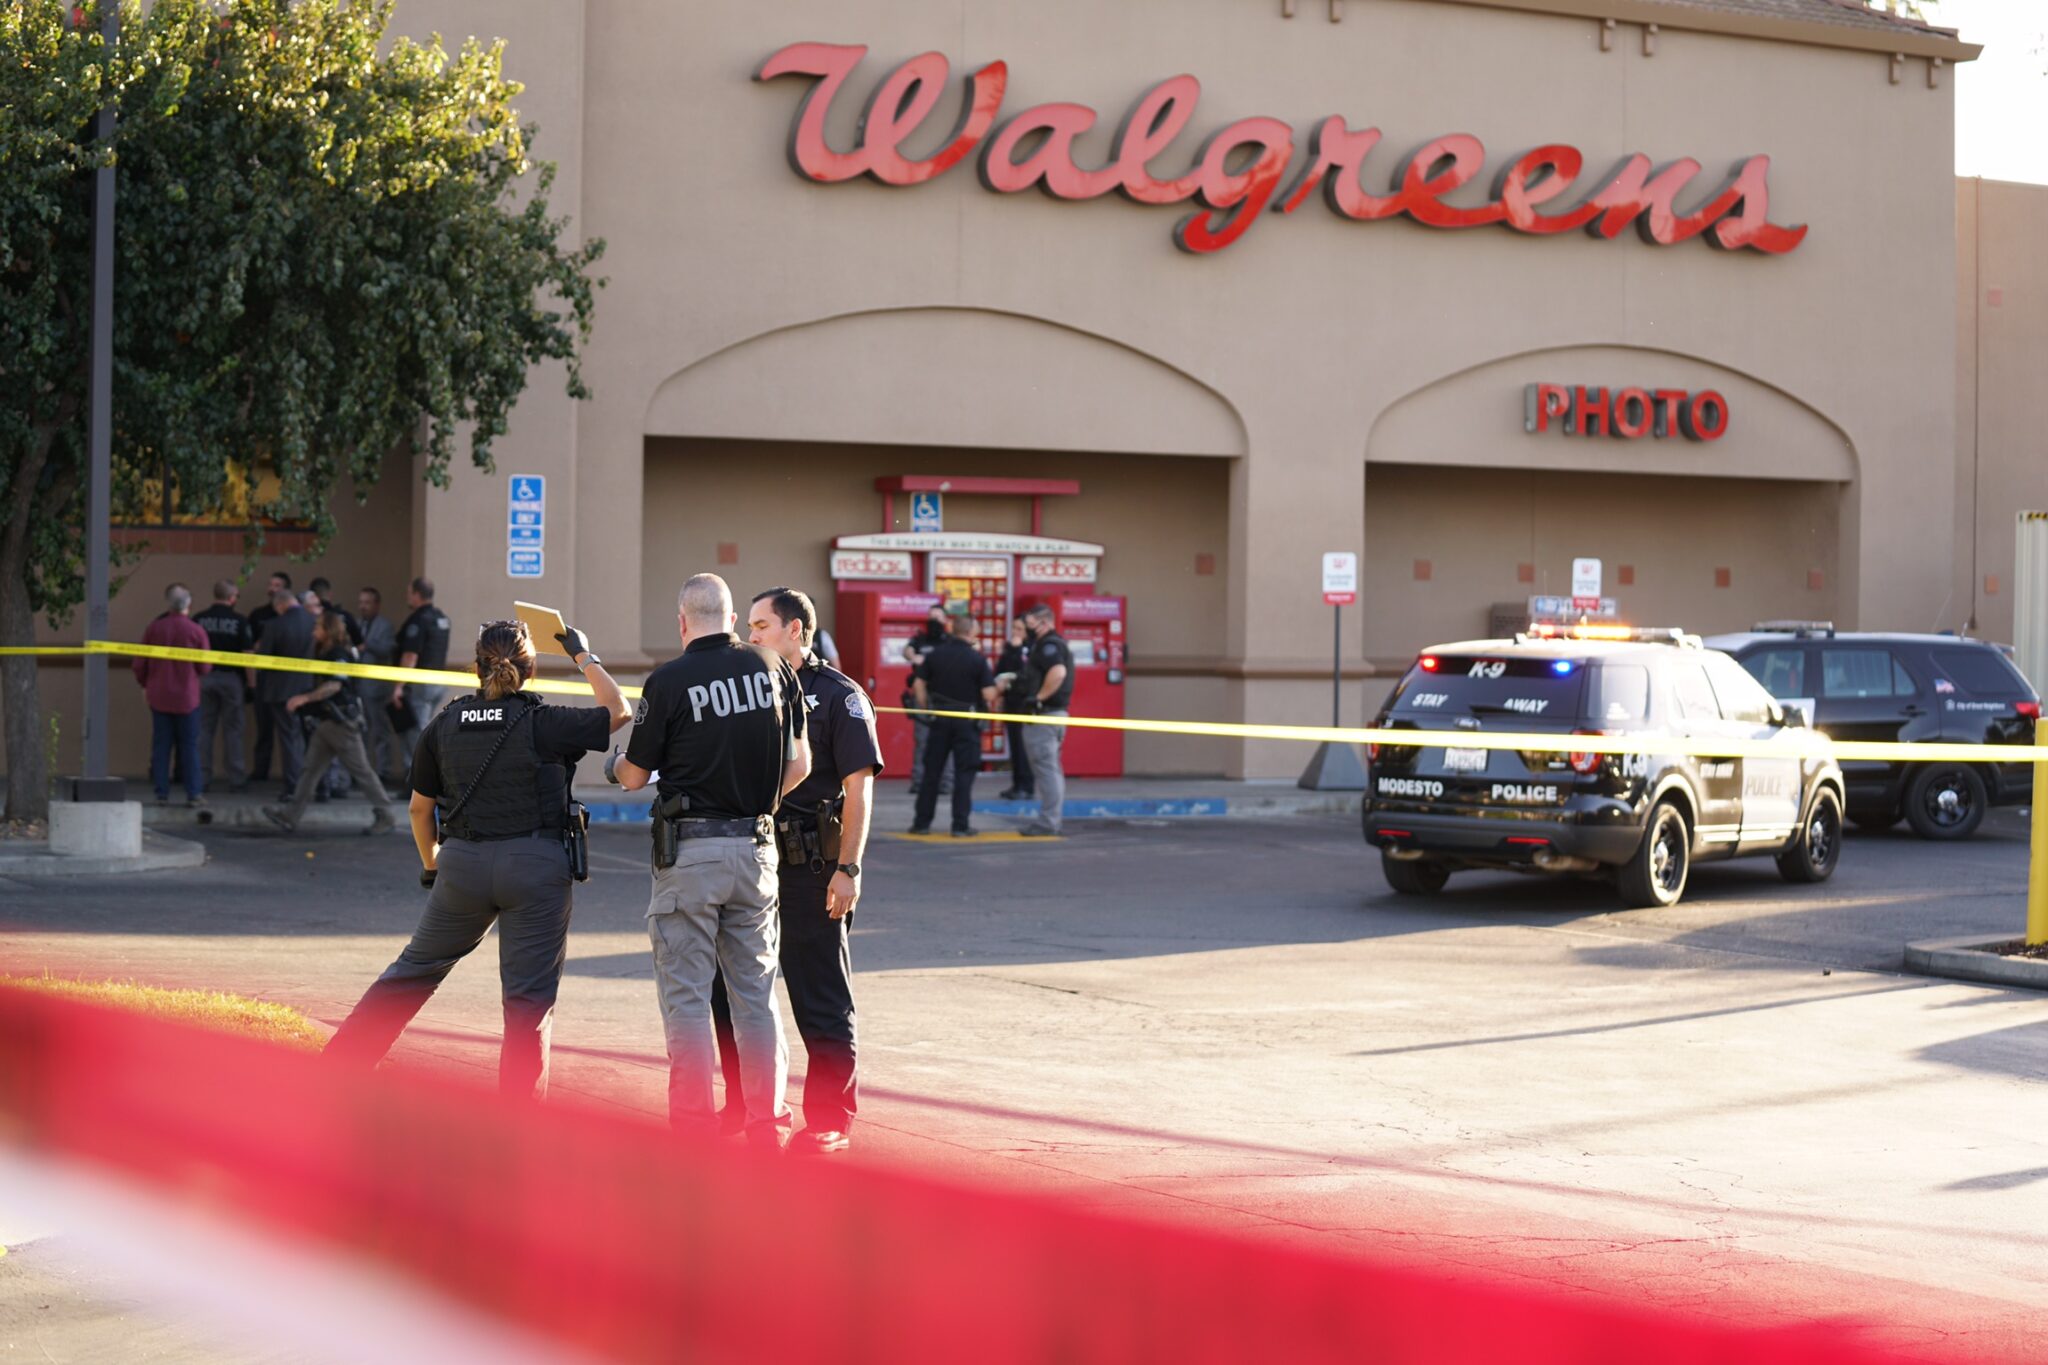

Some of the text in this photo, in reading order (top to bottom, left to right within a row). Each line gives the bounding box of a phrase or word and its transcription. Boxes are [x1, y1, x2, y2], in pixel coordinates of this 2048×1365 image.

[753, 41, 1808, 253] Walgreens
[1526, 381, 1729, 441] PHOTO
[836, 553, 901, 574] redbox
[1027, 557, 1088, 577] redbox
[1468, 661, 1507, 679] K-9
[1412, 693, 1549, 714] STAY AWAY
[461, 708, 503, 723] POLICE
[1378, 777, 1558, 801] MODESTO POLICE
[1745, 776, 1782, 797] POLICE
